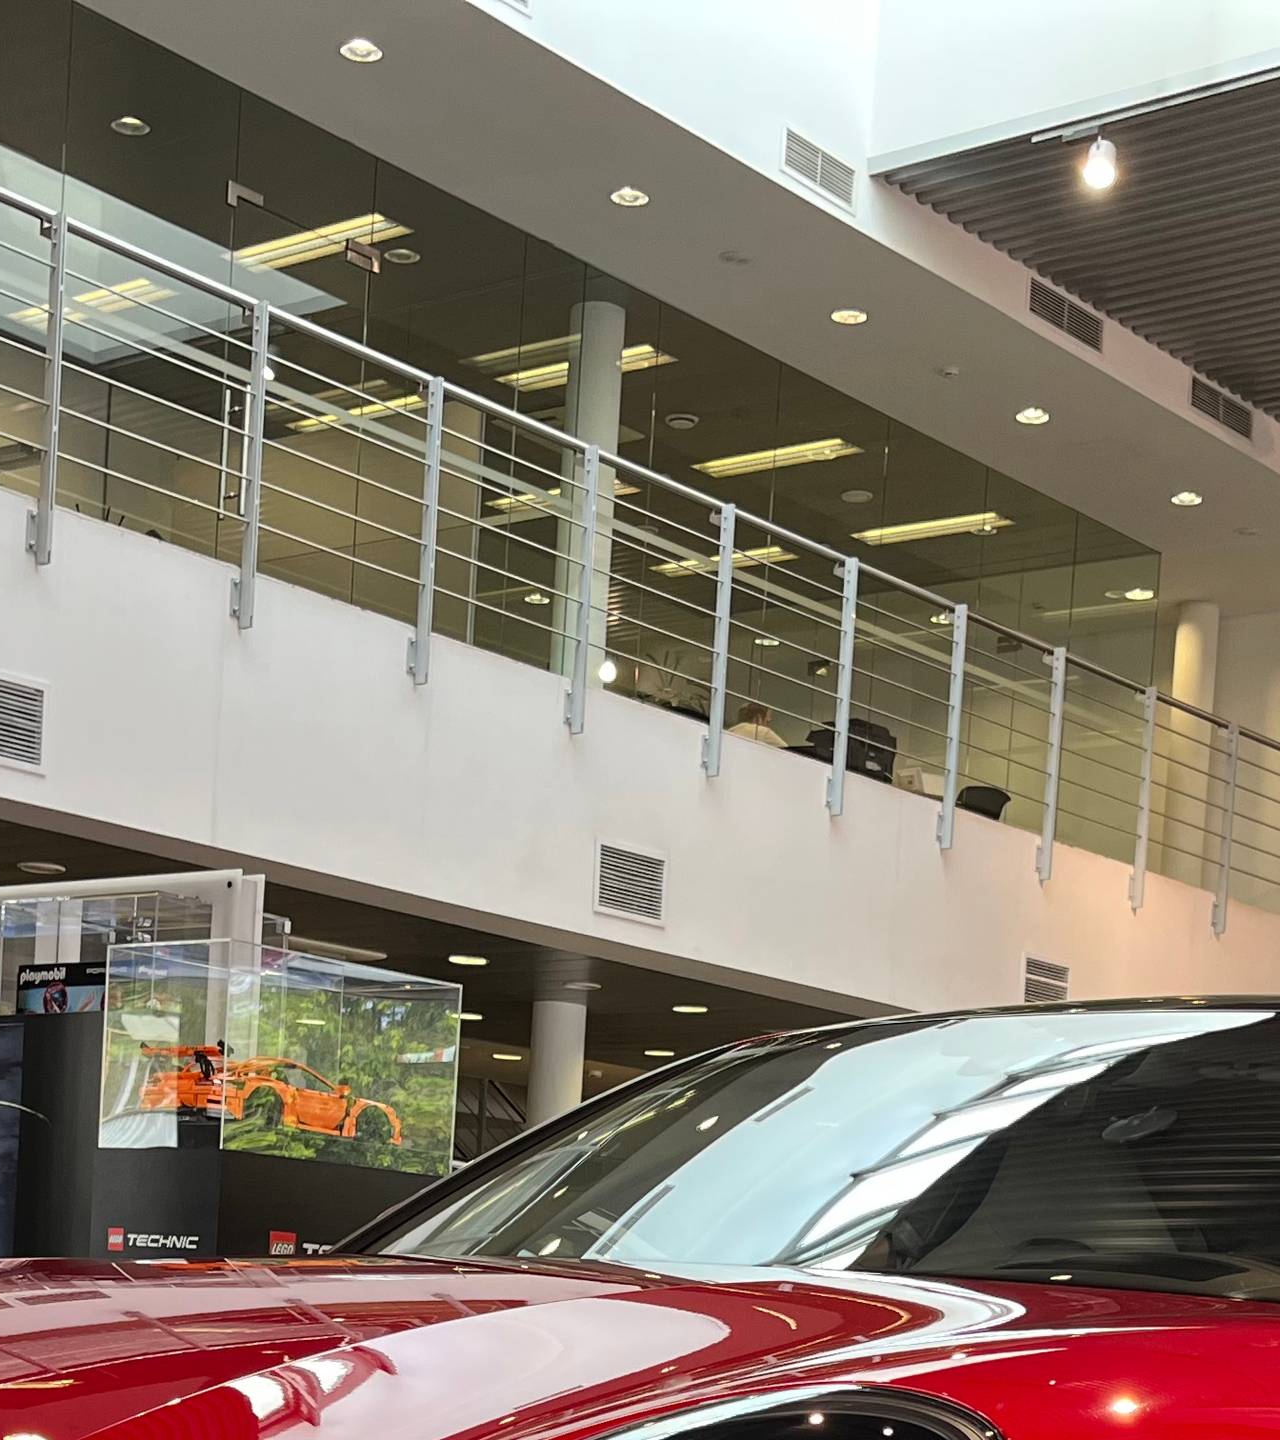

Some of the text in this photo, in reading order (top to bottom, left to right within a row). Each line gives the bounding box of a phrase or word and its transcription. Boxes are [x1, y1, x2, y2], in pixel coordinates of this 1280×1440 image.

[20, 967, 66, 985] playmobil
[127, 1233, 199, 1249] TECHNIC
[271, 1243, 295, 1255] LEGO
